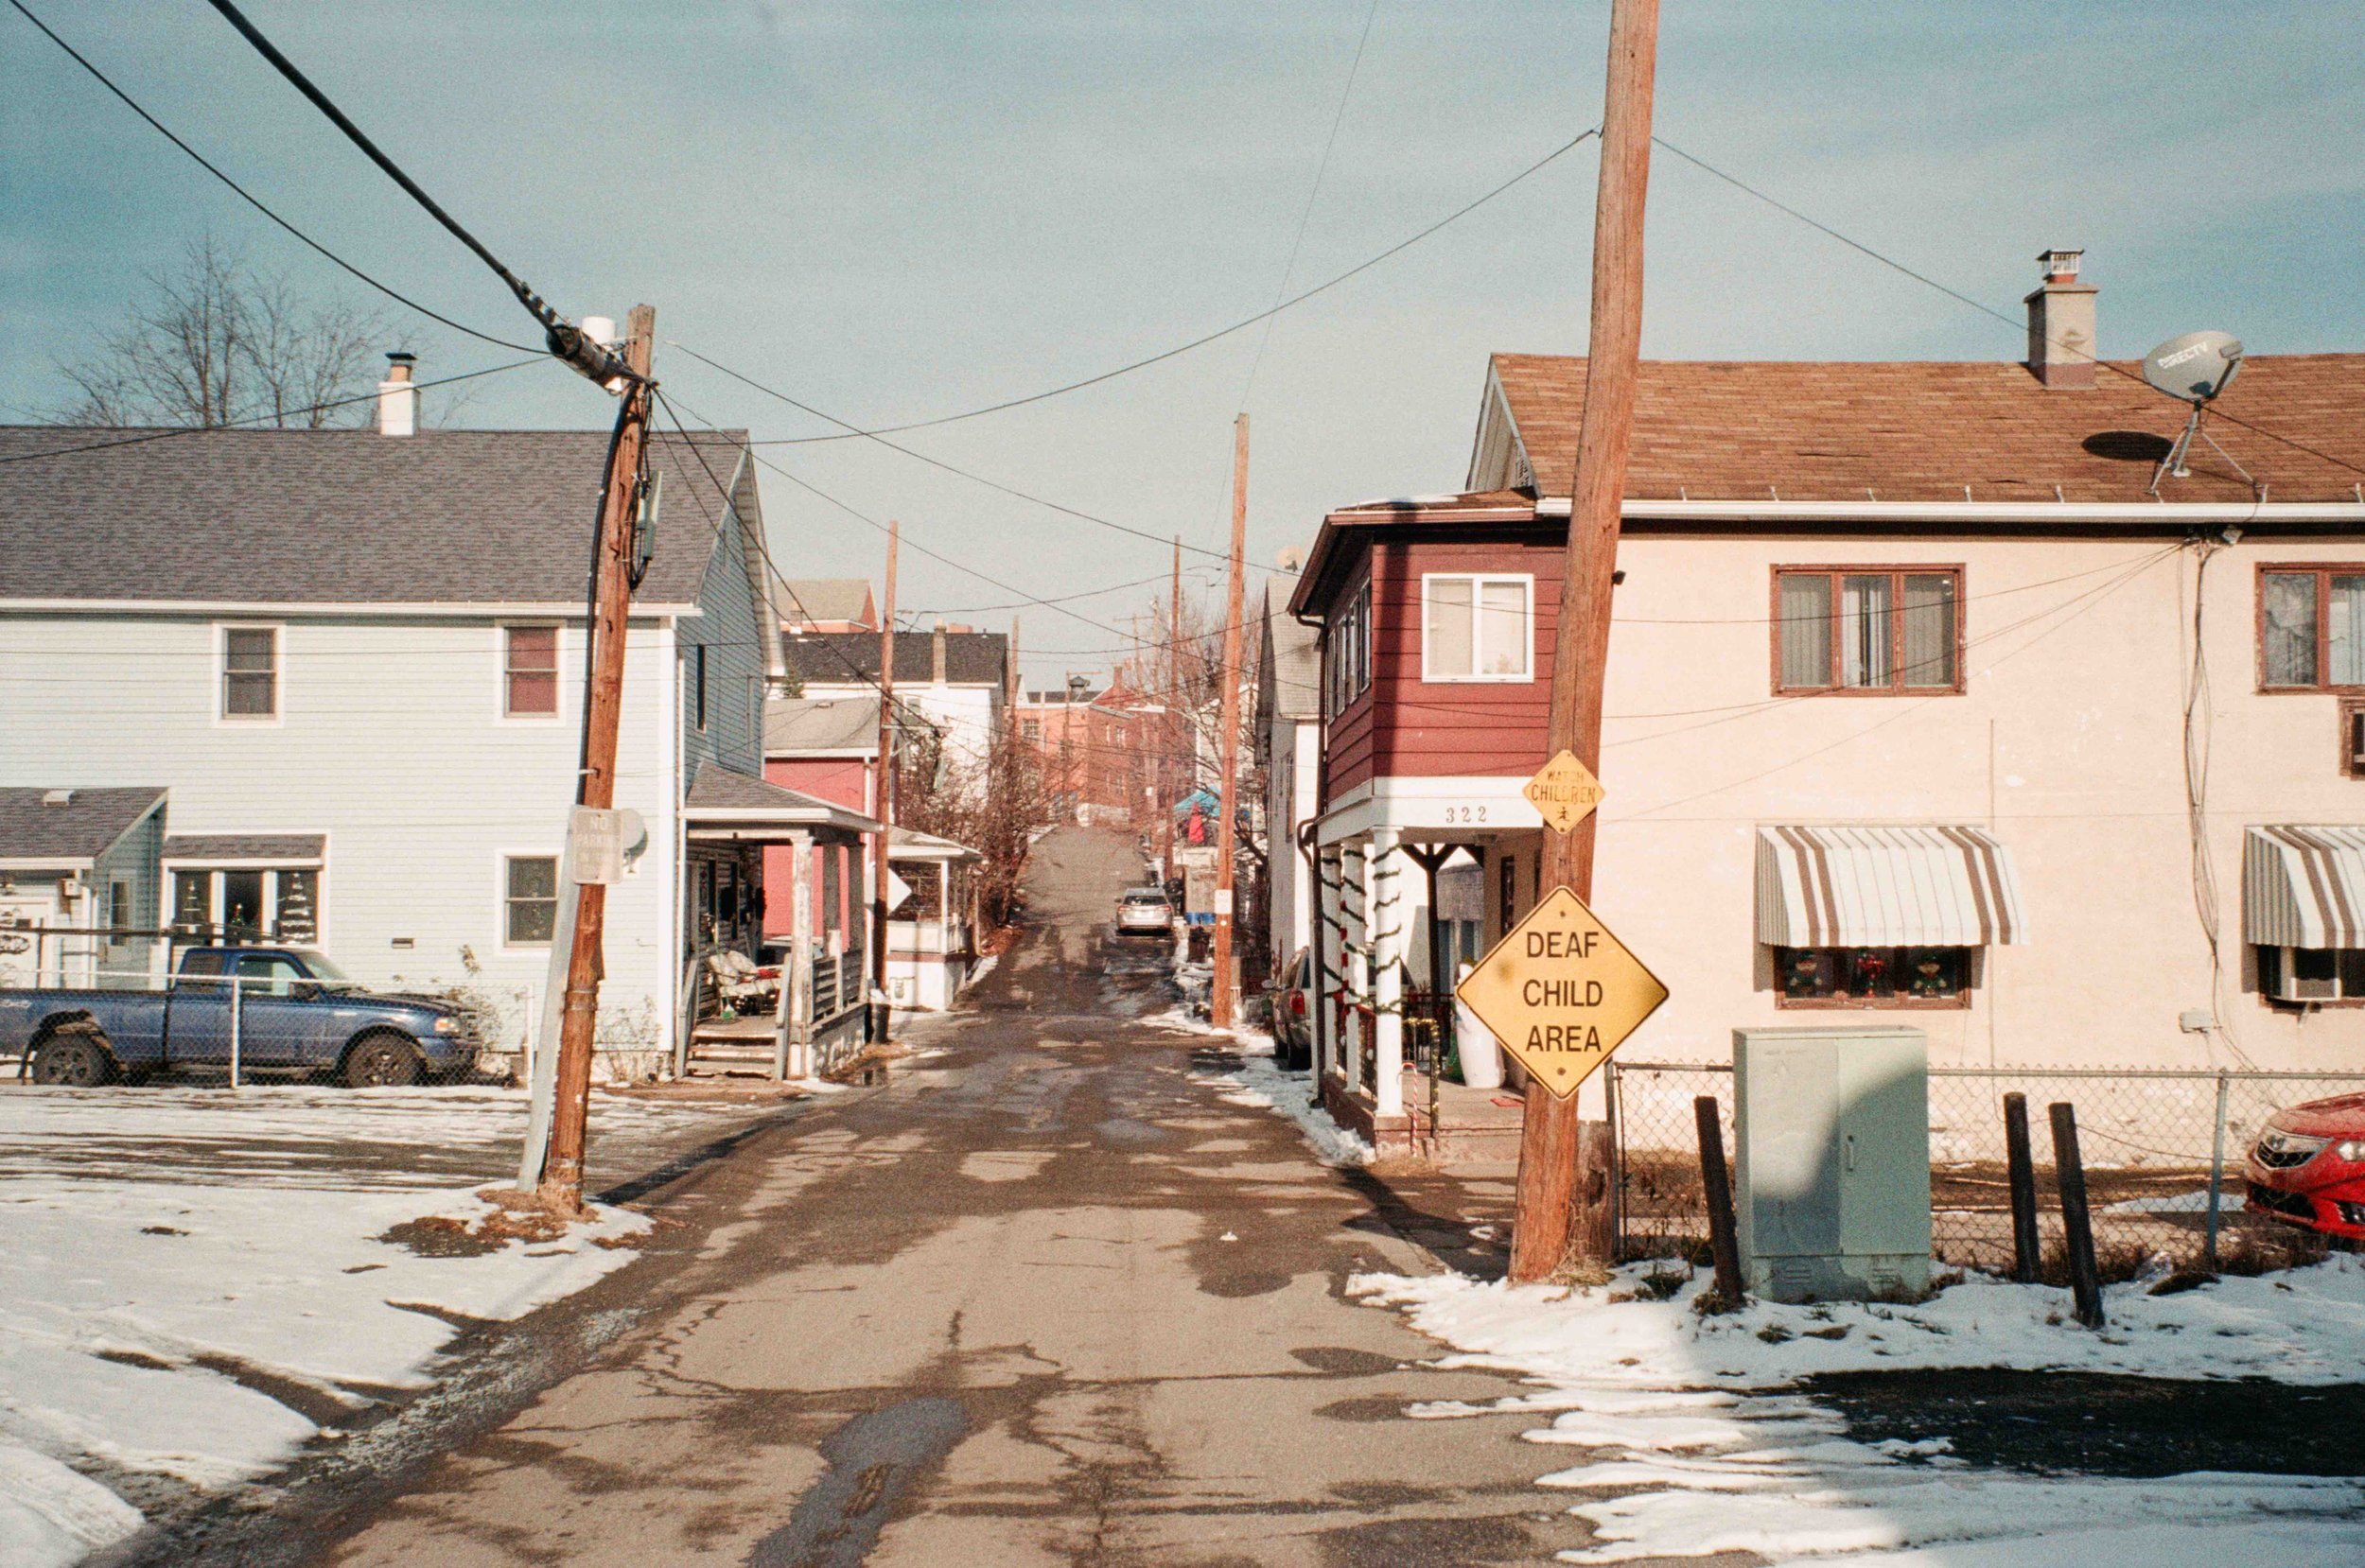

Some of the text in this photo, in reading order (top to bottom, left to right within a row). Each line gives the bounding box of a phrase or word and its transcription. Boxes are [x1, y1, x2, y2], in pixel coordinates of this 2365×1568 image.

[1531, 784, 1596, 803] CHILDREN
[590, 816, 608, 831] NO
[1445, 806, 1487, 824] 322
[1526, 932, 1599, 958] DEAF
[1523, 979, 1603, 1007] CHILD
[1525, 1025, 1602, 1053] AREA
